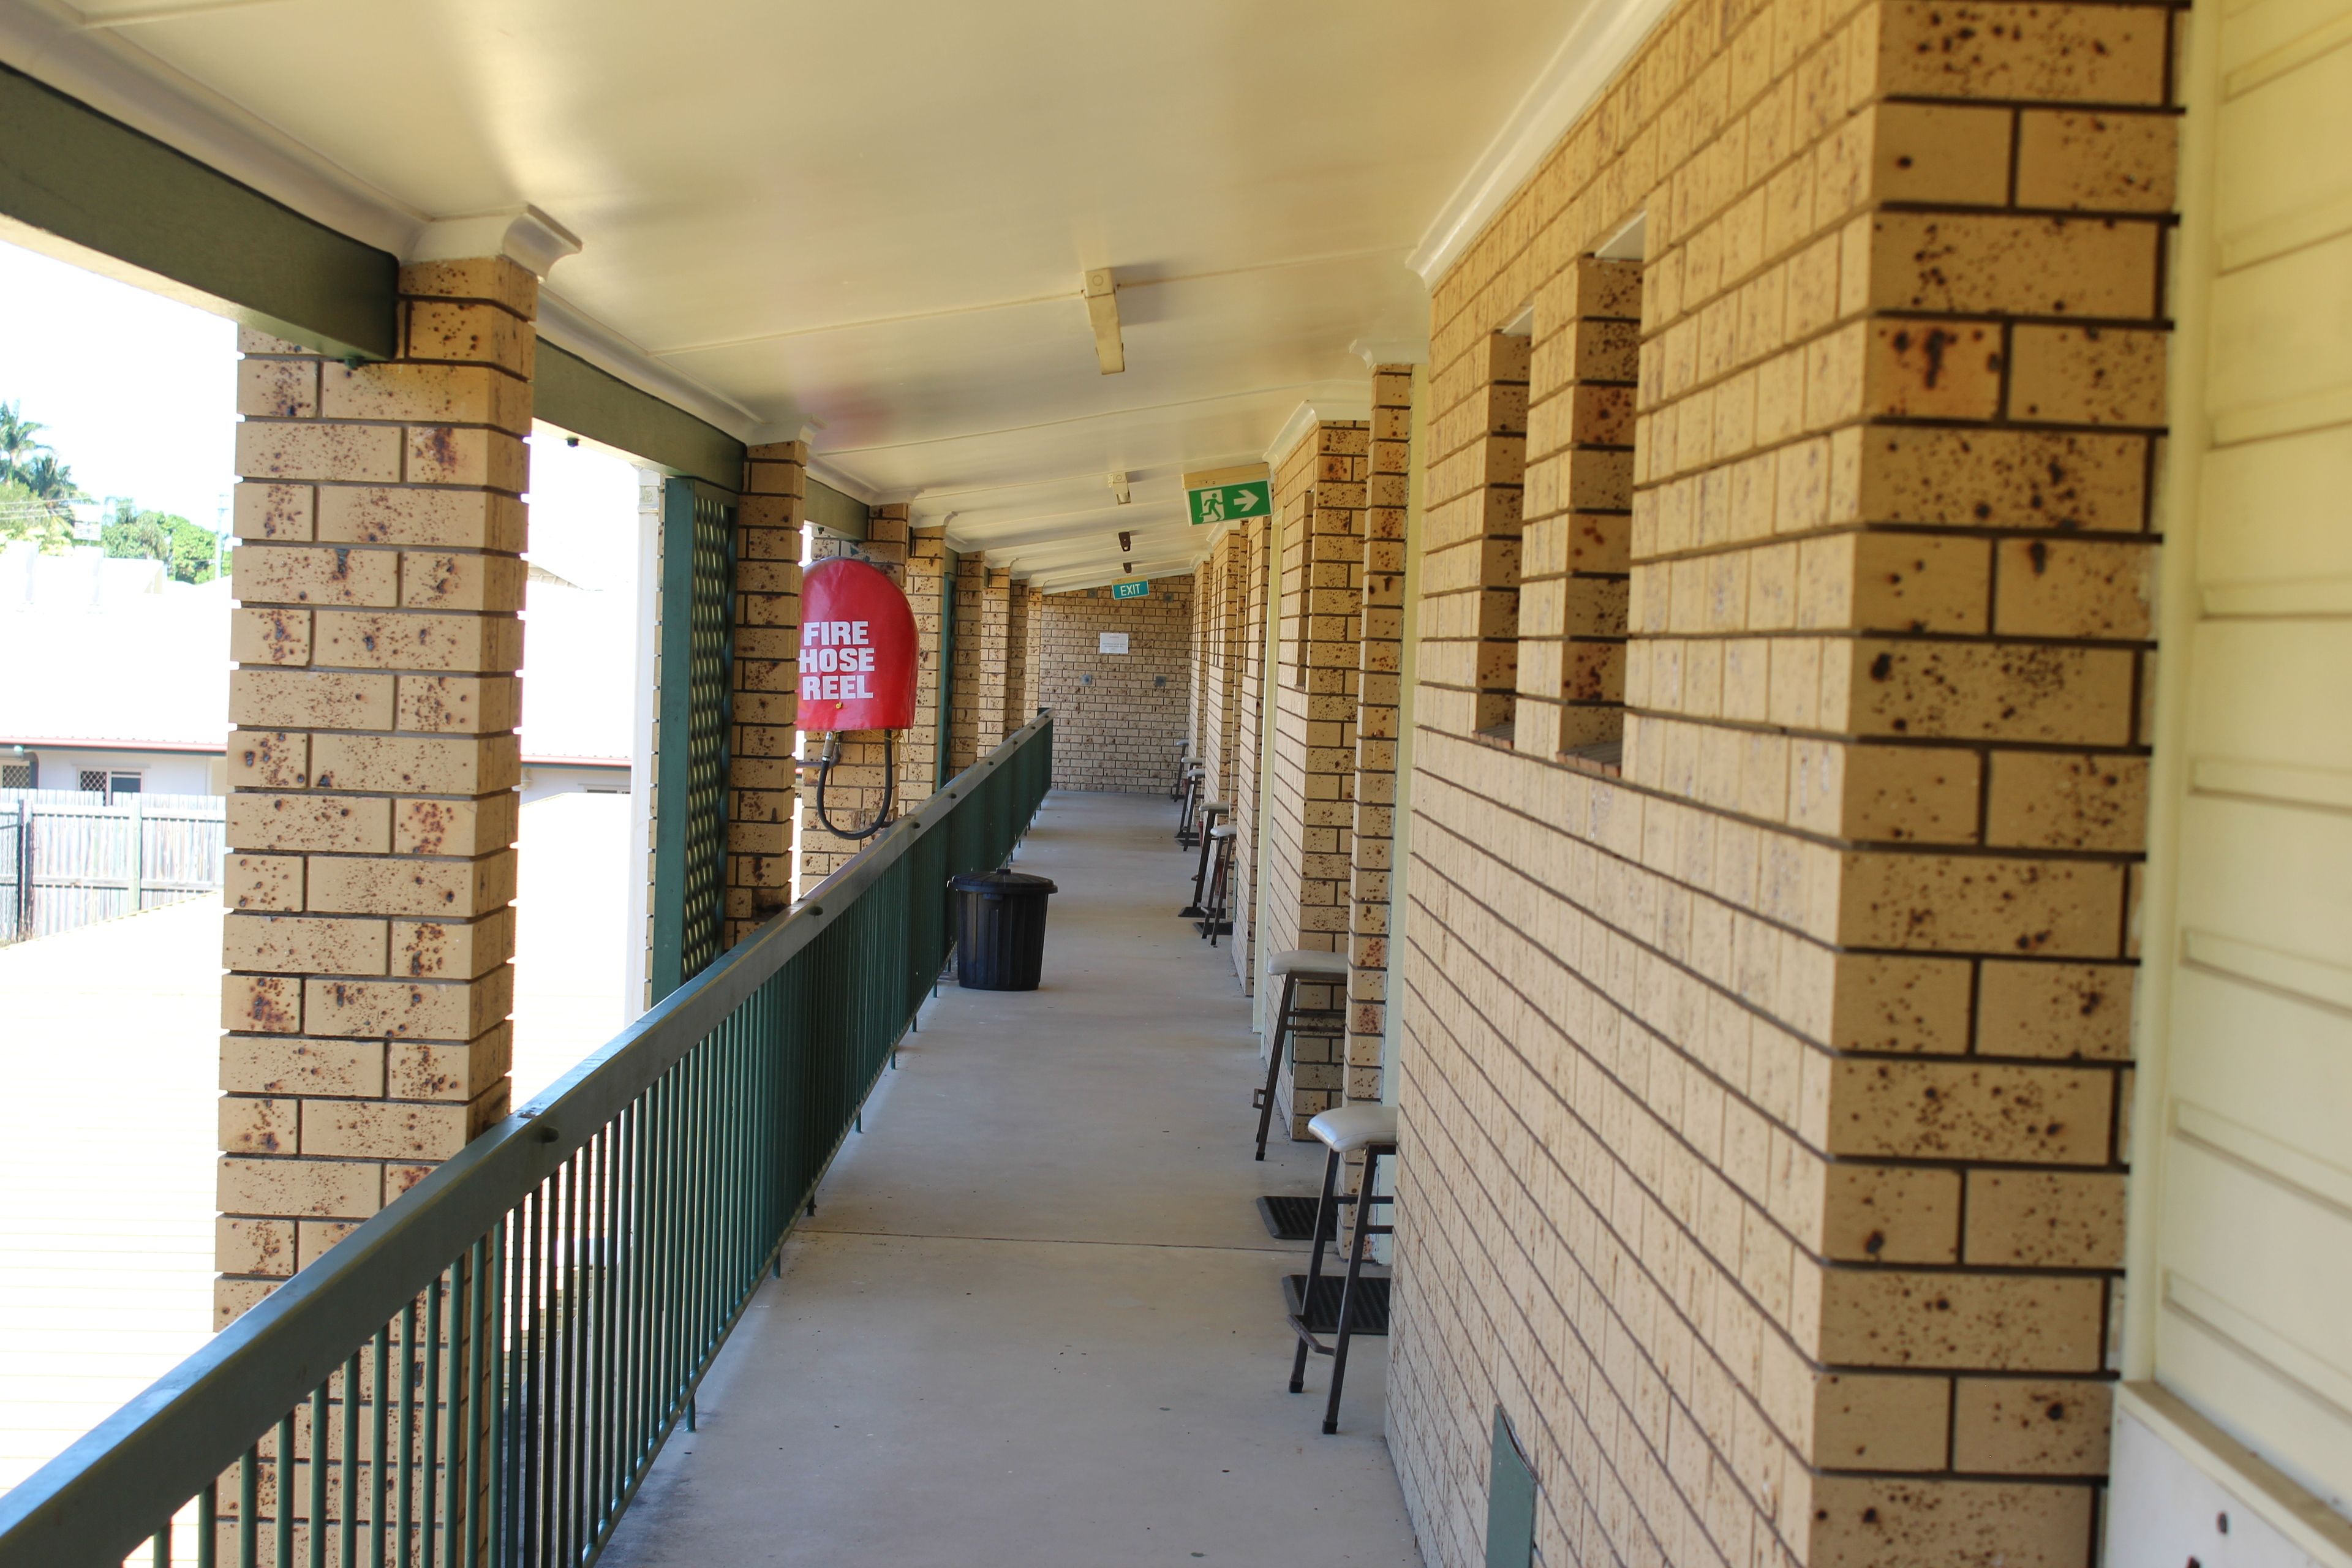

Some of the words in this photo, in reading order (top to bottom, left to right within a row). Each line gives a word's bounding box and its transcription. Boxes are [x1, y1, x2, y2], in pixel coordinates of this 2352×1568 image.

[1120, 583, 1140, 596] EXIT
[804, 621, 869, 646] FIRE
[799, 647, 875, 673] HOSE
[802, 675, 873, 700] REEL
